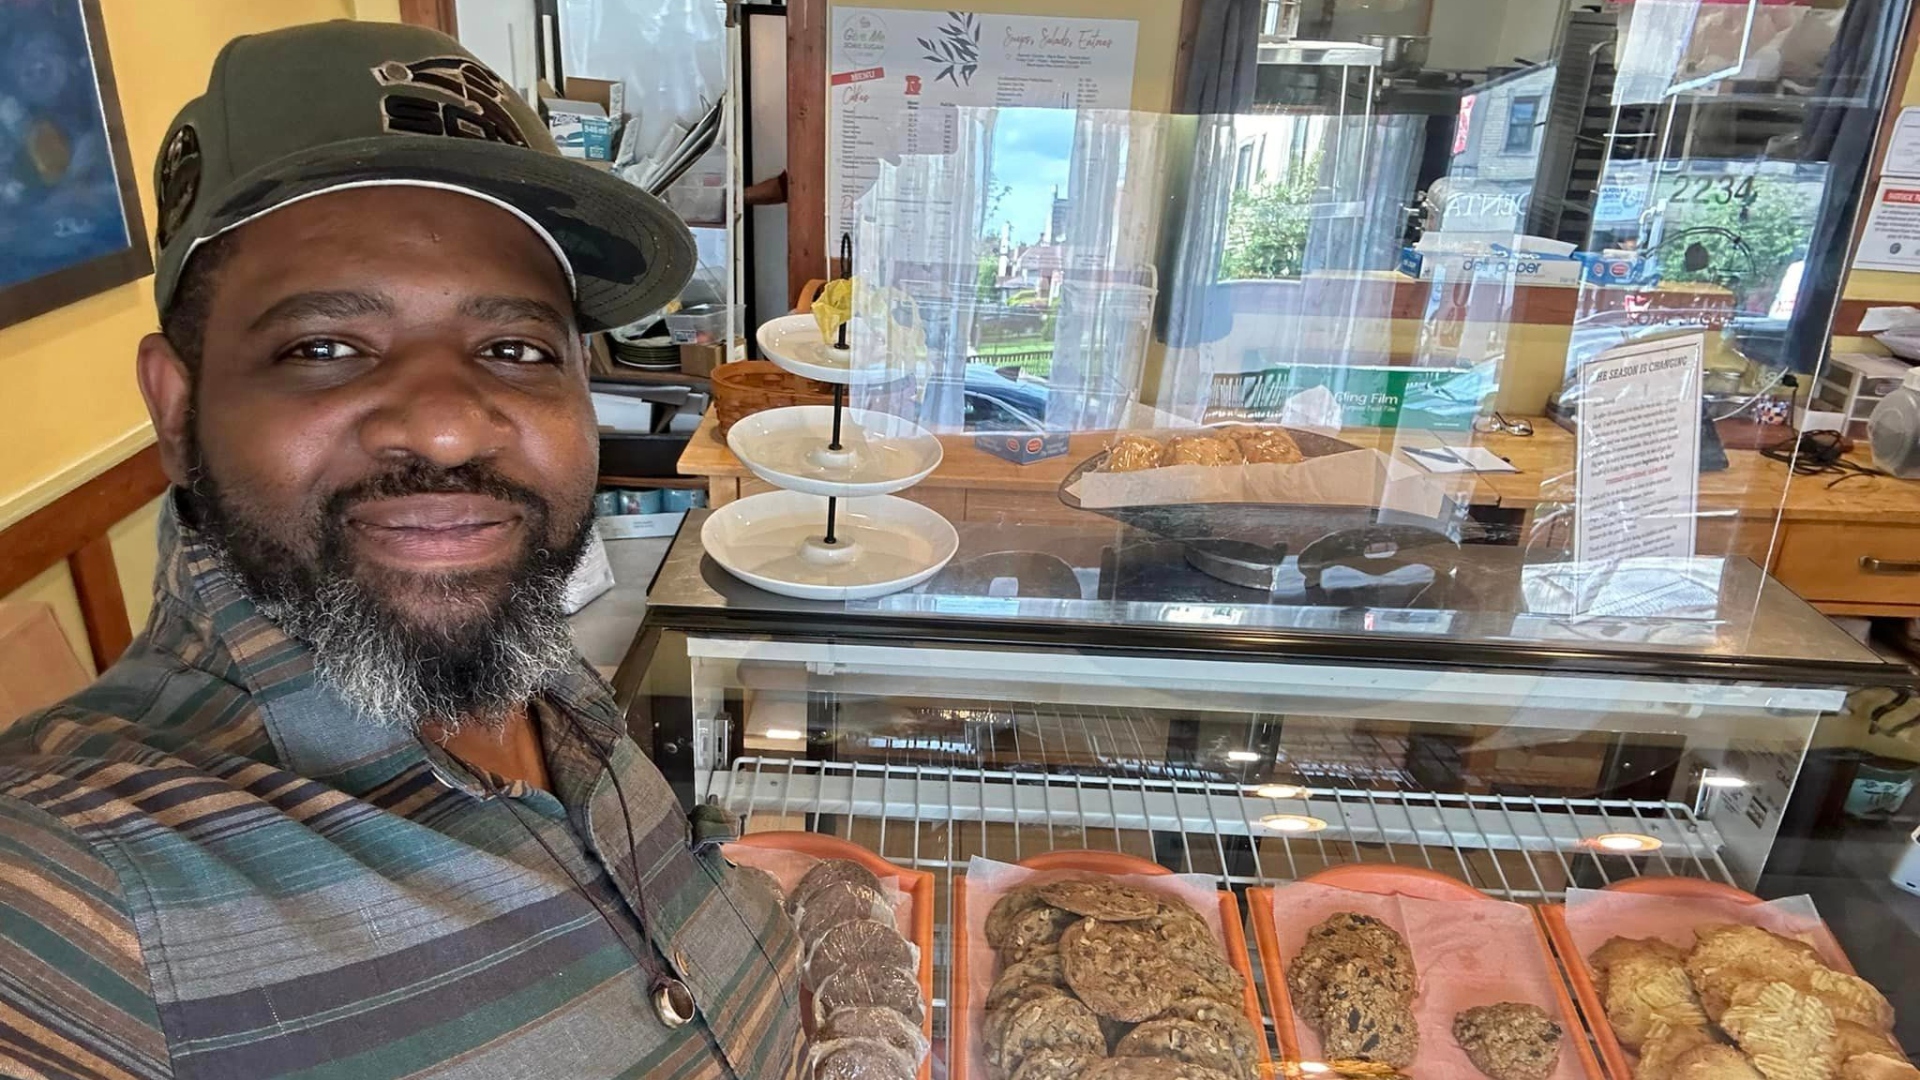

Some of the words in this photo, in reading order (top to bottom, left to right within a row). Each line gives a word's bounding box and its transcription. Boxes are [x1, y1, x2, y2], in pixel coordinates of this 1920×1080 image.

[850, 71, 875, 81] MENU
[1668, 174, 1755, 205] 2234
[1463, 258, 1490, 272] deli
[1495, 261, 1542, 276] paper
[1595, 371, 1608, 382] HE
[1609, 364, 1640, 380] SEASON
[1639, 363, 1648, 375] IS
[1648, 356, 1688, 373] CHANGING
[1334, 391, 1368, 406] Cling
[1370, 392, 1399, 405] Film
